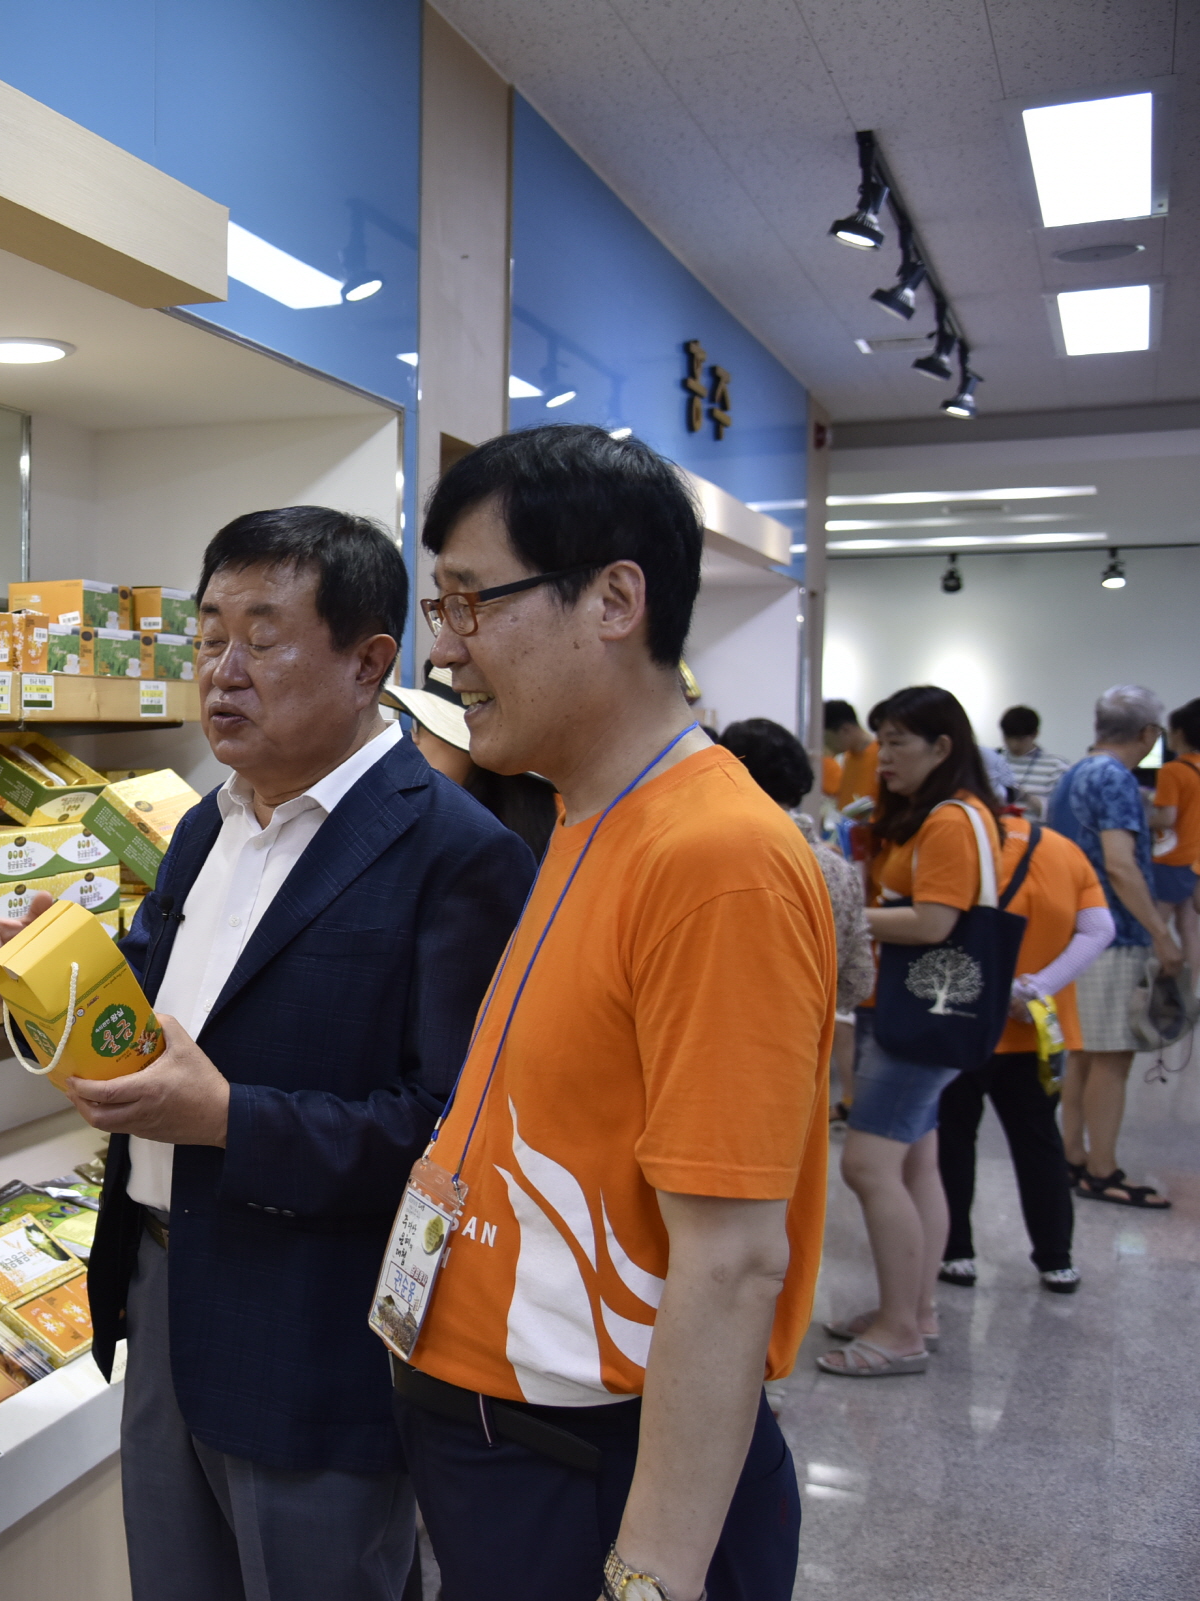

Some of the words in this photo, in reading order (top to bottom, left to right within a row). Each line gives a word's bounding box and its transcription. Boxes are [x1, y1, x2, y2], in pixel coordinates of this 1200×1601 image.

[95, 1018, 111, 1033] 속이편한
[110, 1007, 125, 1023] 왕실
[99, 1018, 134, 1054] 울금
